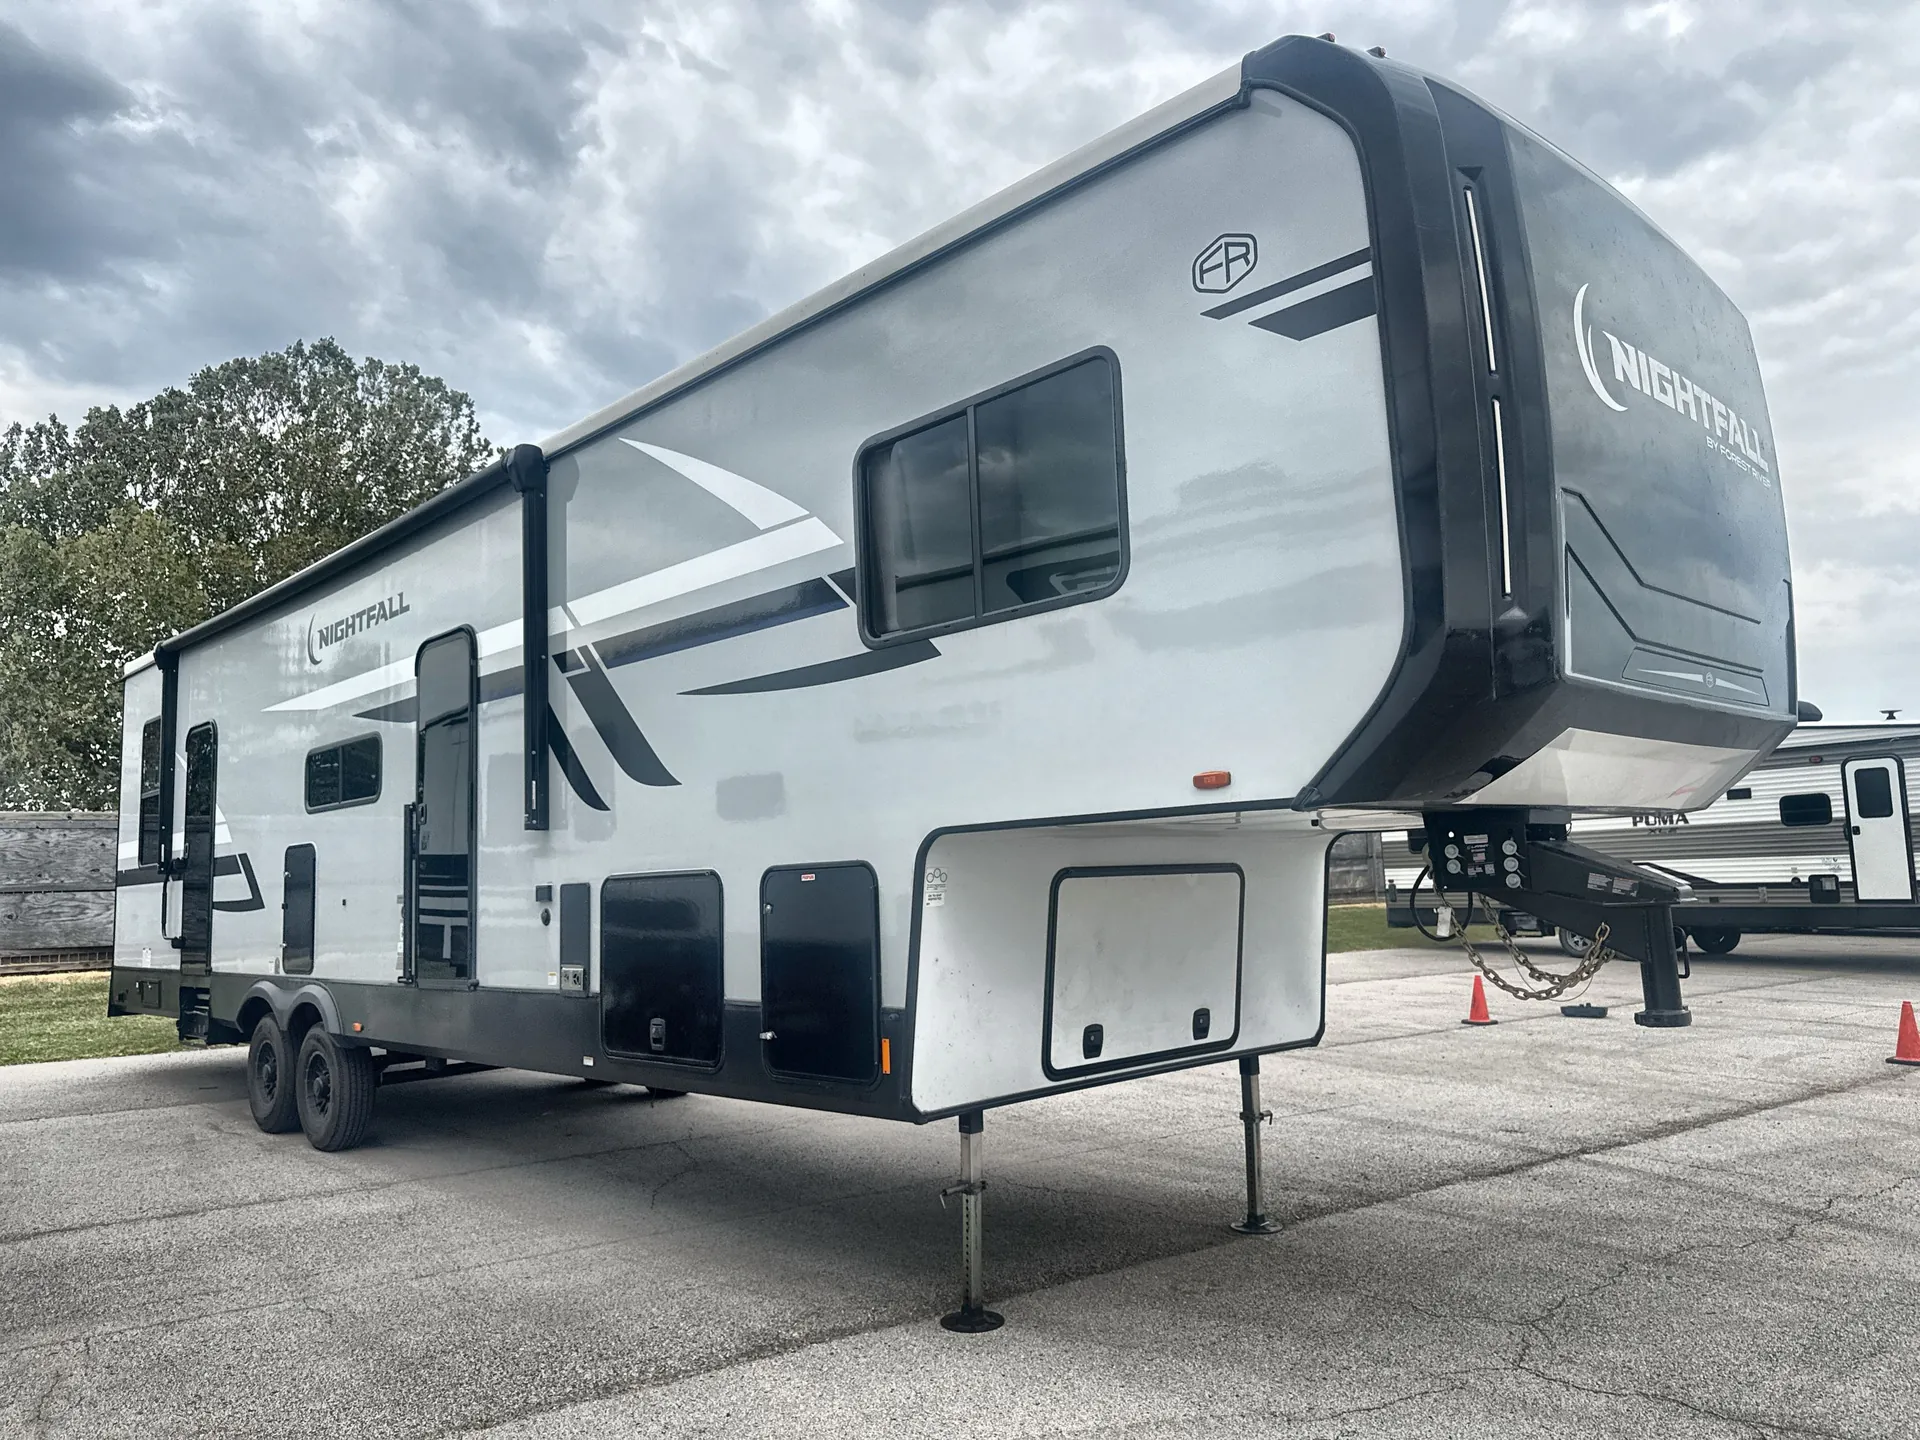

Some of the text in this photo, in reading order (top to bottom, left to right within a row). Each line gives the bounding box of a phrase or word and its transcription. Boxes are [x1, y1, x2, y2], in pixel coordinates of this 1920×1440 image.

[1199, 241, 1251, 285] FR
[1601, 329, 1769, 473] NIGHTFALL
[1705, 435, 1772, 490] BY FOREST RIVER
[317, 591, 411, 650] NIGHTFALL
[1631, 812, 1690, 827] PUMA
